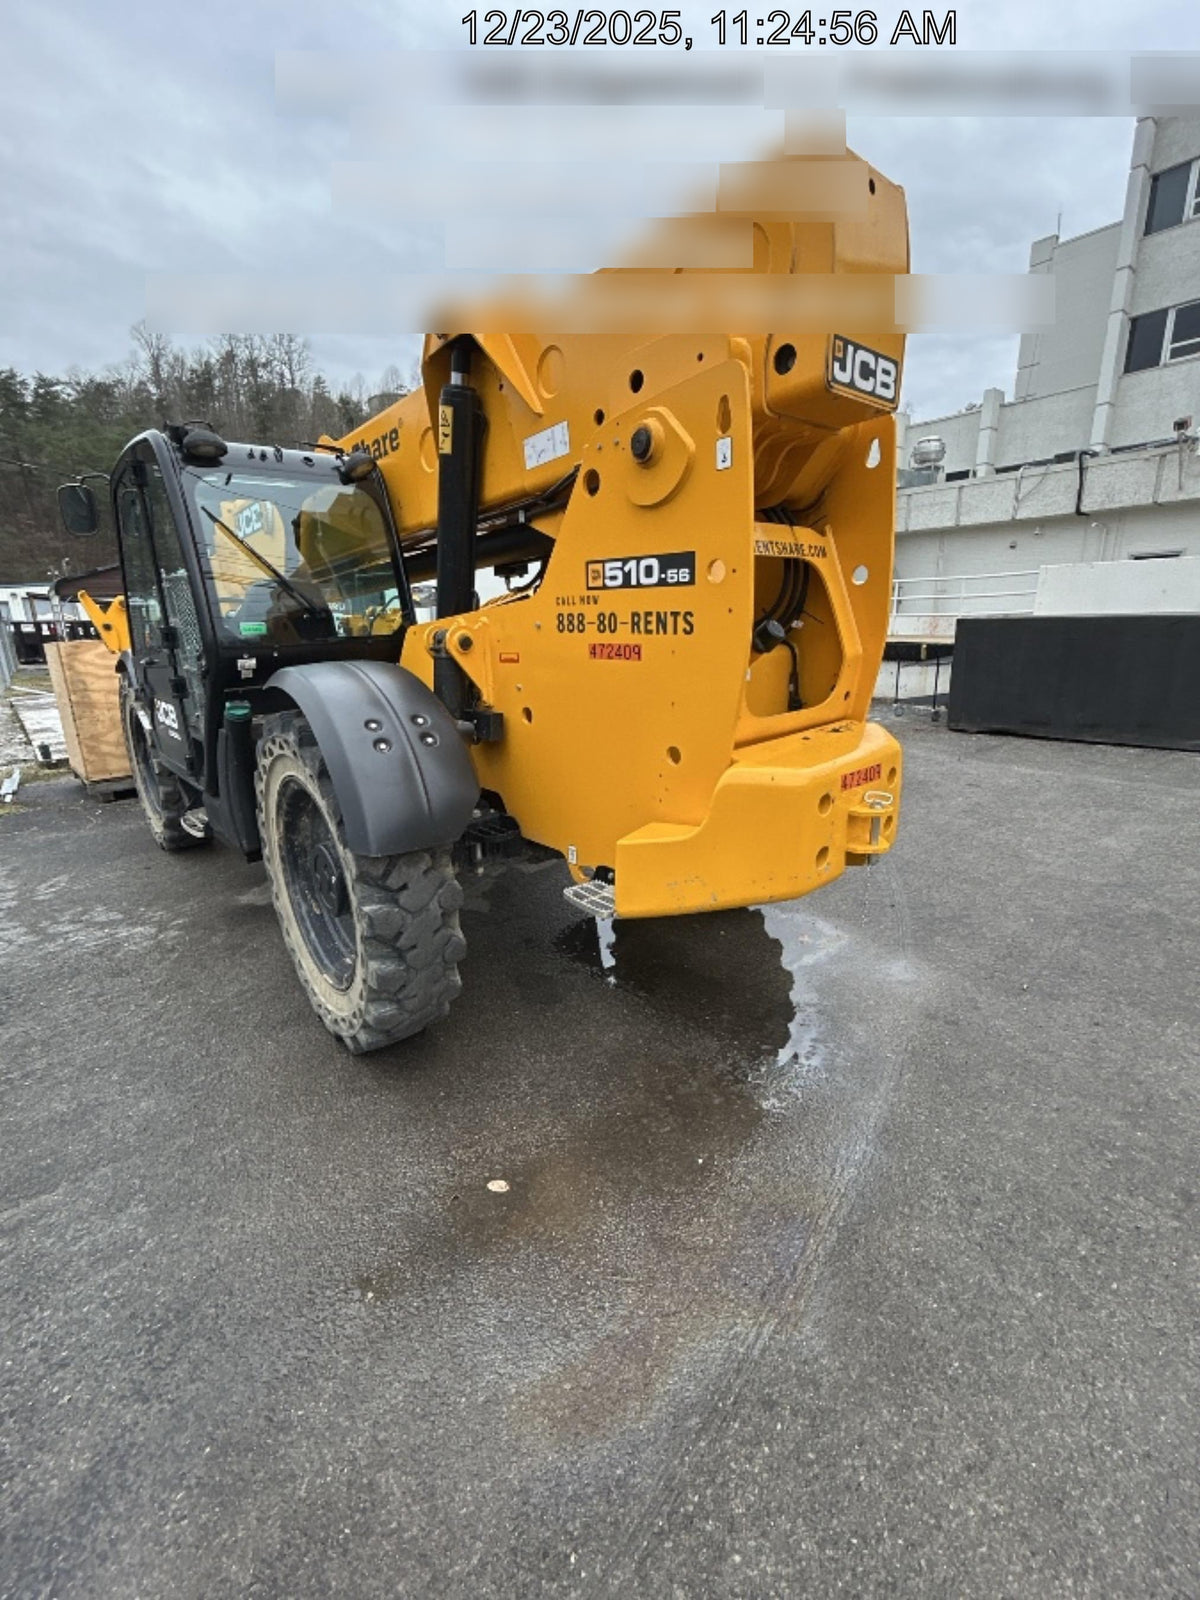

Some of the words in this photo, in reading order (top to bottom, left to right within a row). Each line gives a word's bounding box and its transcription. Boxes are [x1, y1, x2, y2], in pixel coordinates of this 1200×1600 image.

[833, 344, 897, 400] JCB
[557, 611, 694, 635] 888-80-RENTS
[589, 643, 642, 661] 472409
